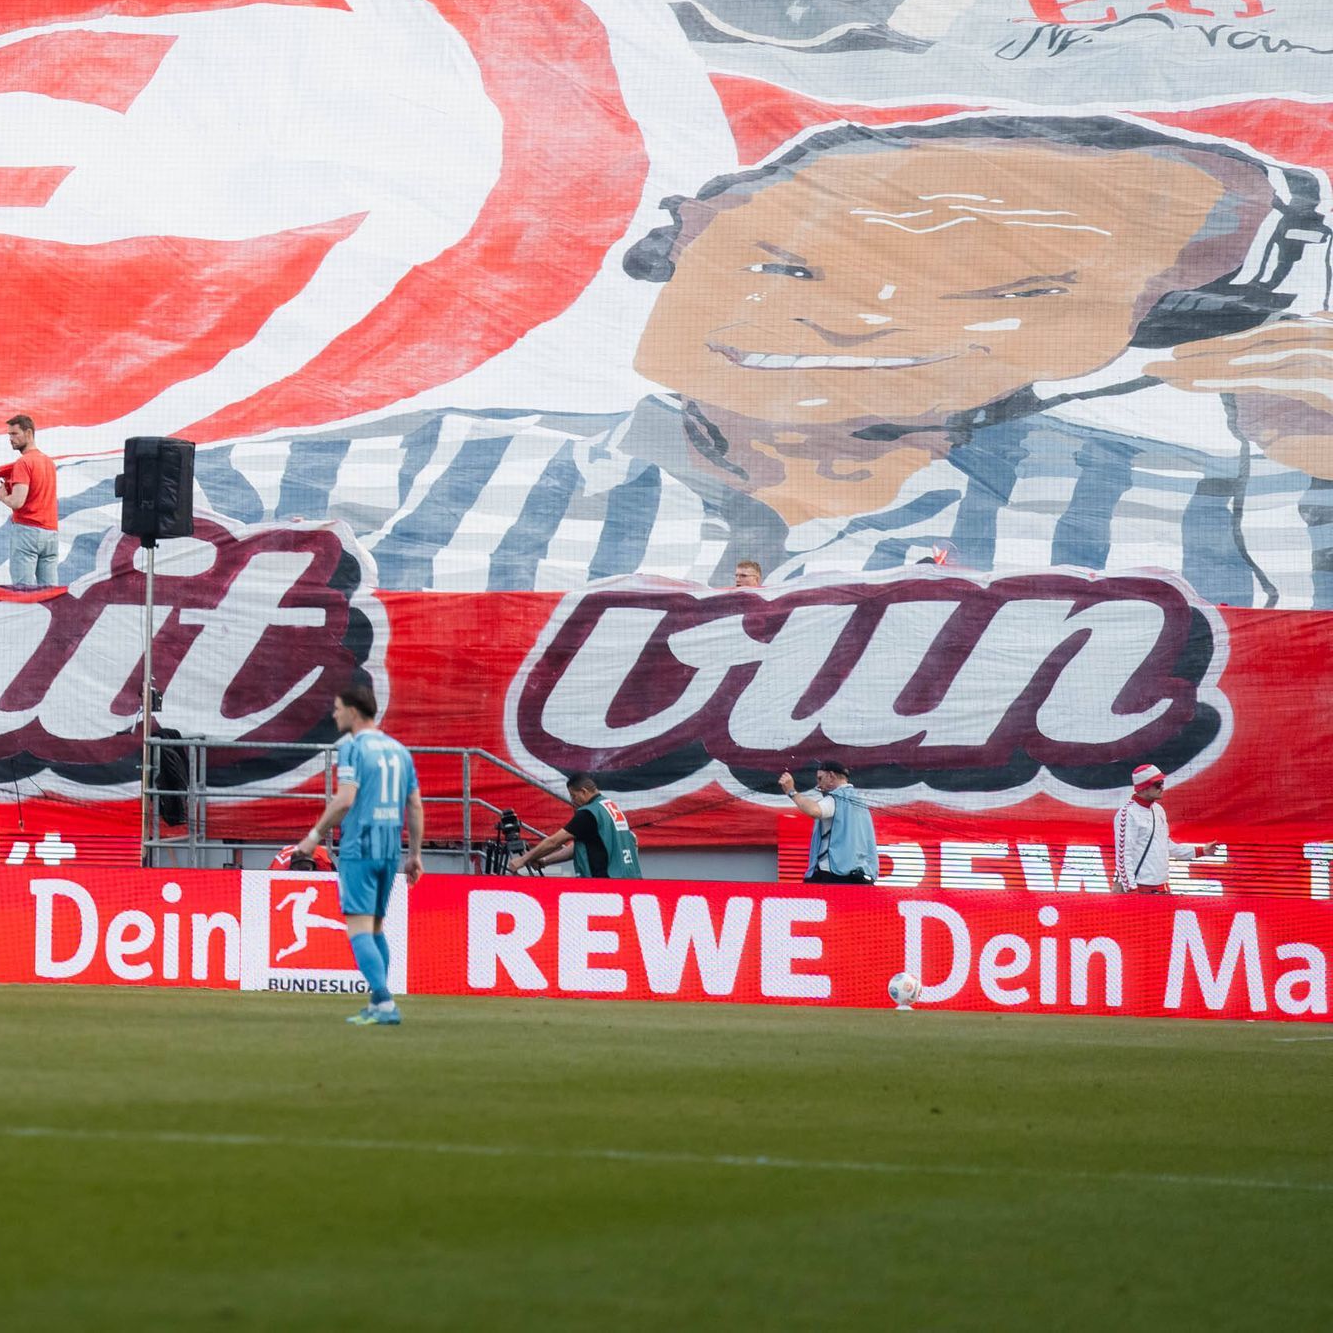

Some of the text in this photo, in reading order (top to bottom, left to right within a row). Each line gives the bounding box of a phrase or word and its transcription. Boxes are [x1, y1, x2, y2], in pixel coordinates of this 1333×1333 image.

[376, 753, 402, 804] 11
[29, 877, 241, 981] Dein
[467, 889, 832, 1000] REWE
[896, 899, 1124, 1008] Dein
